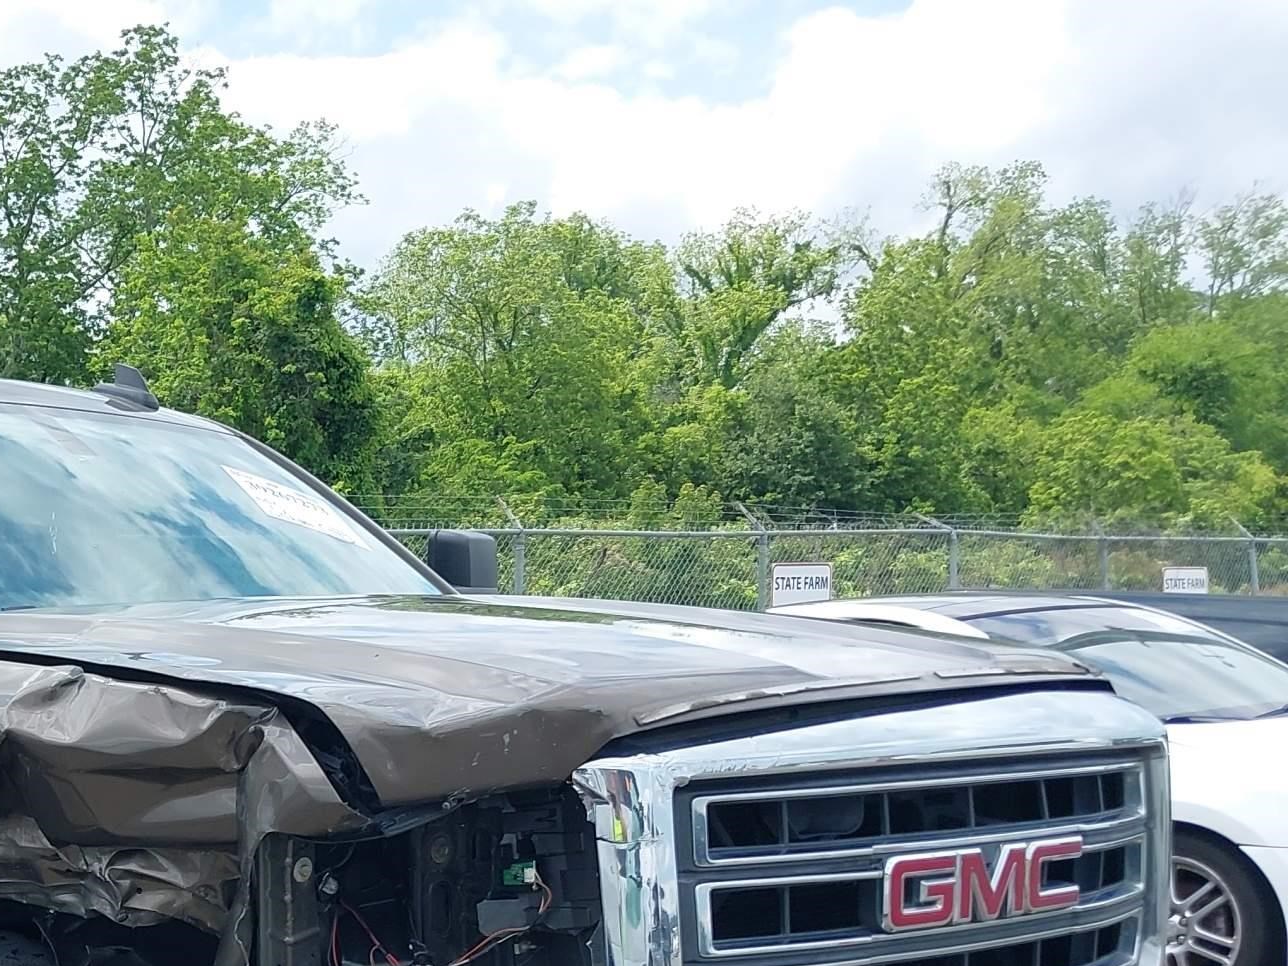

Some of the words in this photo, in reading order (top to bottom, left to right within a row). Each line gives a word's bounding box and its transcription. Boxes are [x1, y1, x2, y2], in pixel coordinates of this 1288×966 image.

[775, 576, 802, 591] STATE
[803, 576, 828, 591] FARM
[1165, 577, 1186, 590] STATE
[882, 836, 1083, 933] GMC
